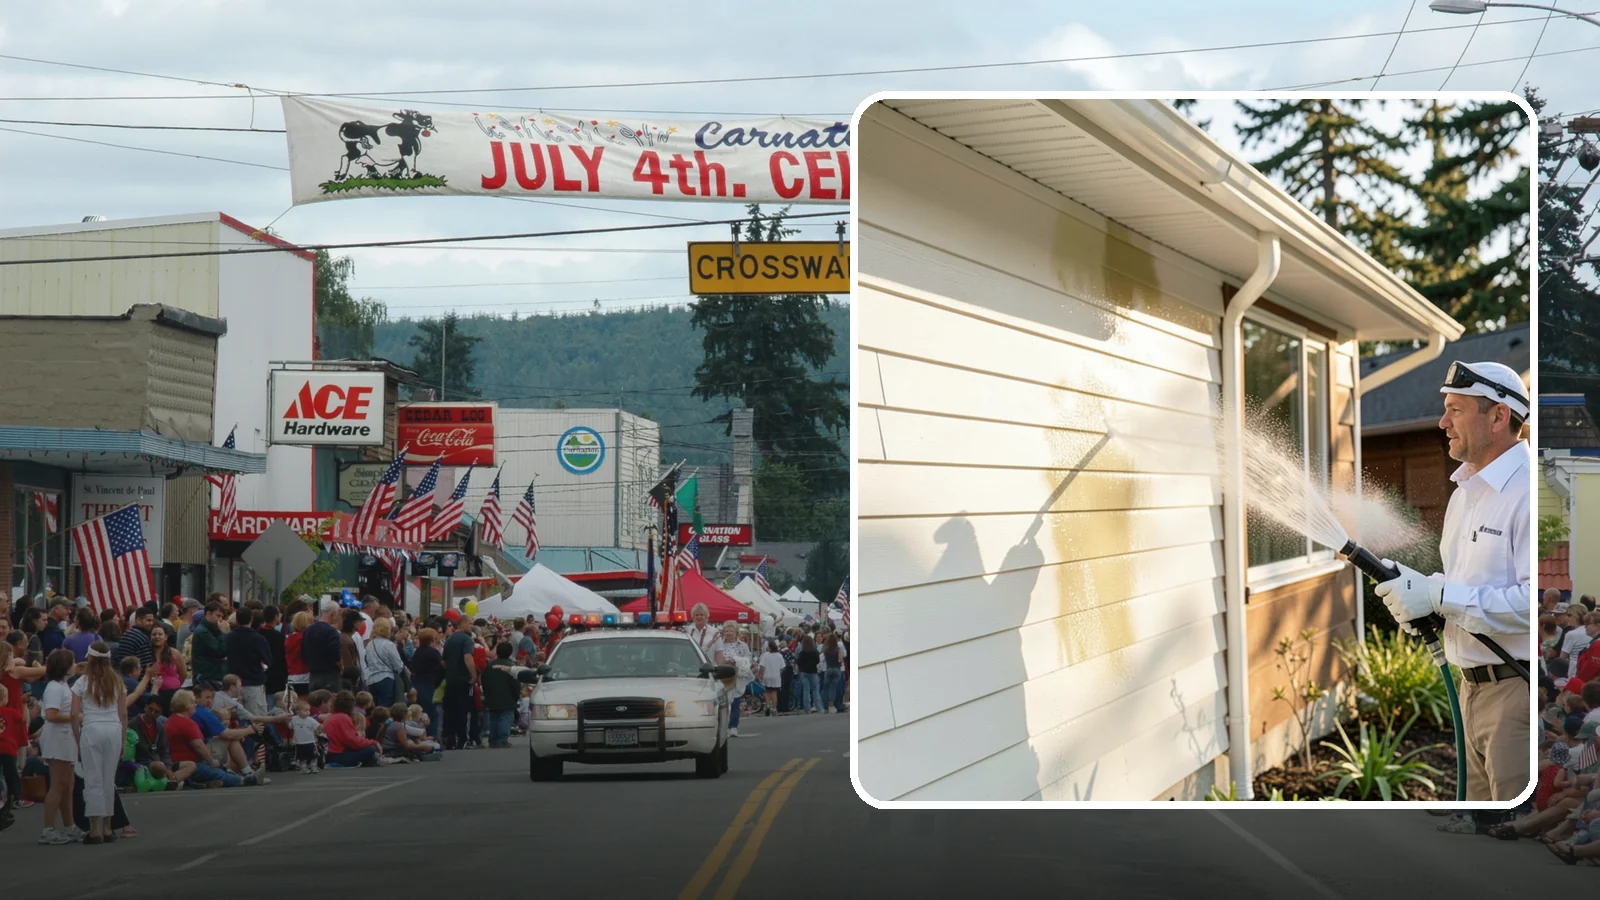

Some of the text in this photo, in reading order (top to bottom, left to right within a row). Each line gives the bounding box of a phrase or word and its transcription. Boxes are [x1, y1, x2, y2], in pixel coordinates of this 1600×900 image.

[481, 141, 605, 193] JULY
[632, 150, 747, 198] 4th.
[697, 254, 850, 280] CROSSWA
[283, 380, 373, 420] ACE
[405, 409, 452, 421] CEDAR
[283, 421, 371, 436] Hardware
[353, 467, 384, 480] Simpl
[83, 485, 155, 495] St. Vincent de Paul
[81, 503, 154, 522] THT
[213, 516, 331, 537] HARDARE
[688, 526, 741, 535] CRNATION
[699, 535, 730, 543] GLASS
